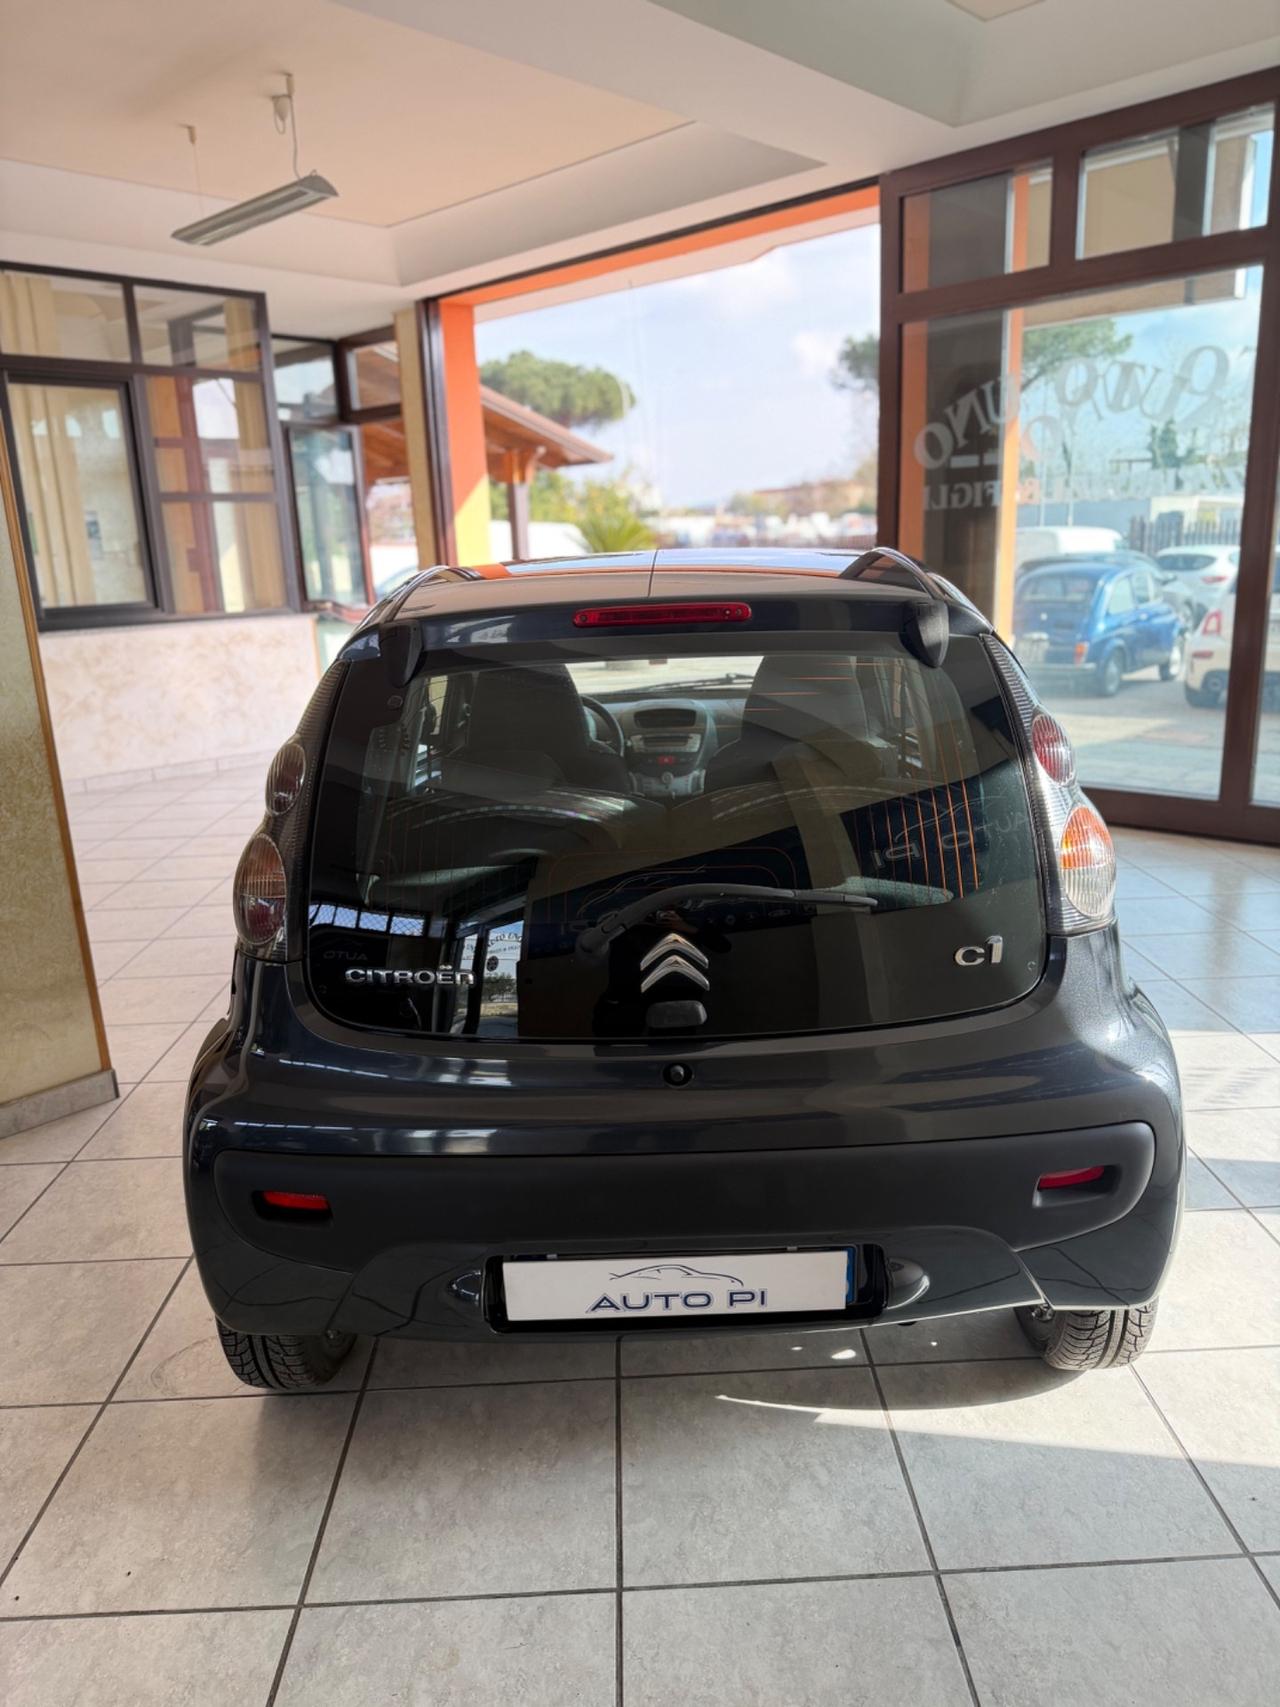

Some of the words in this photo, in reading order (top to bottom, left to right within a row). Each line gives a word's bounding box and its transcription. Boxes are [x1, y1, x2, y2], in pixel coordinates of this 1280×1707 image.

[954, 934, 1004, 966] C1
[587, 1291, 713, 1313] AUTO
[728, 1290, 768, 1309] PI
